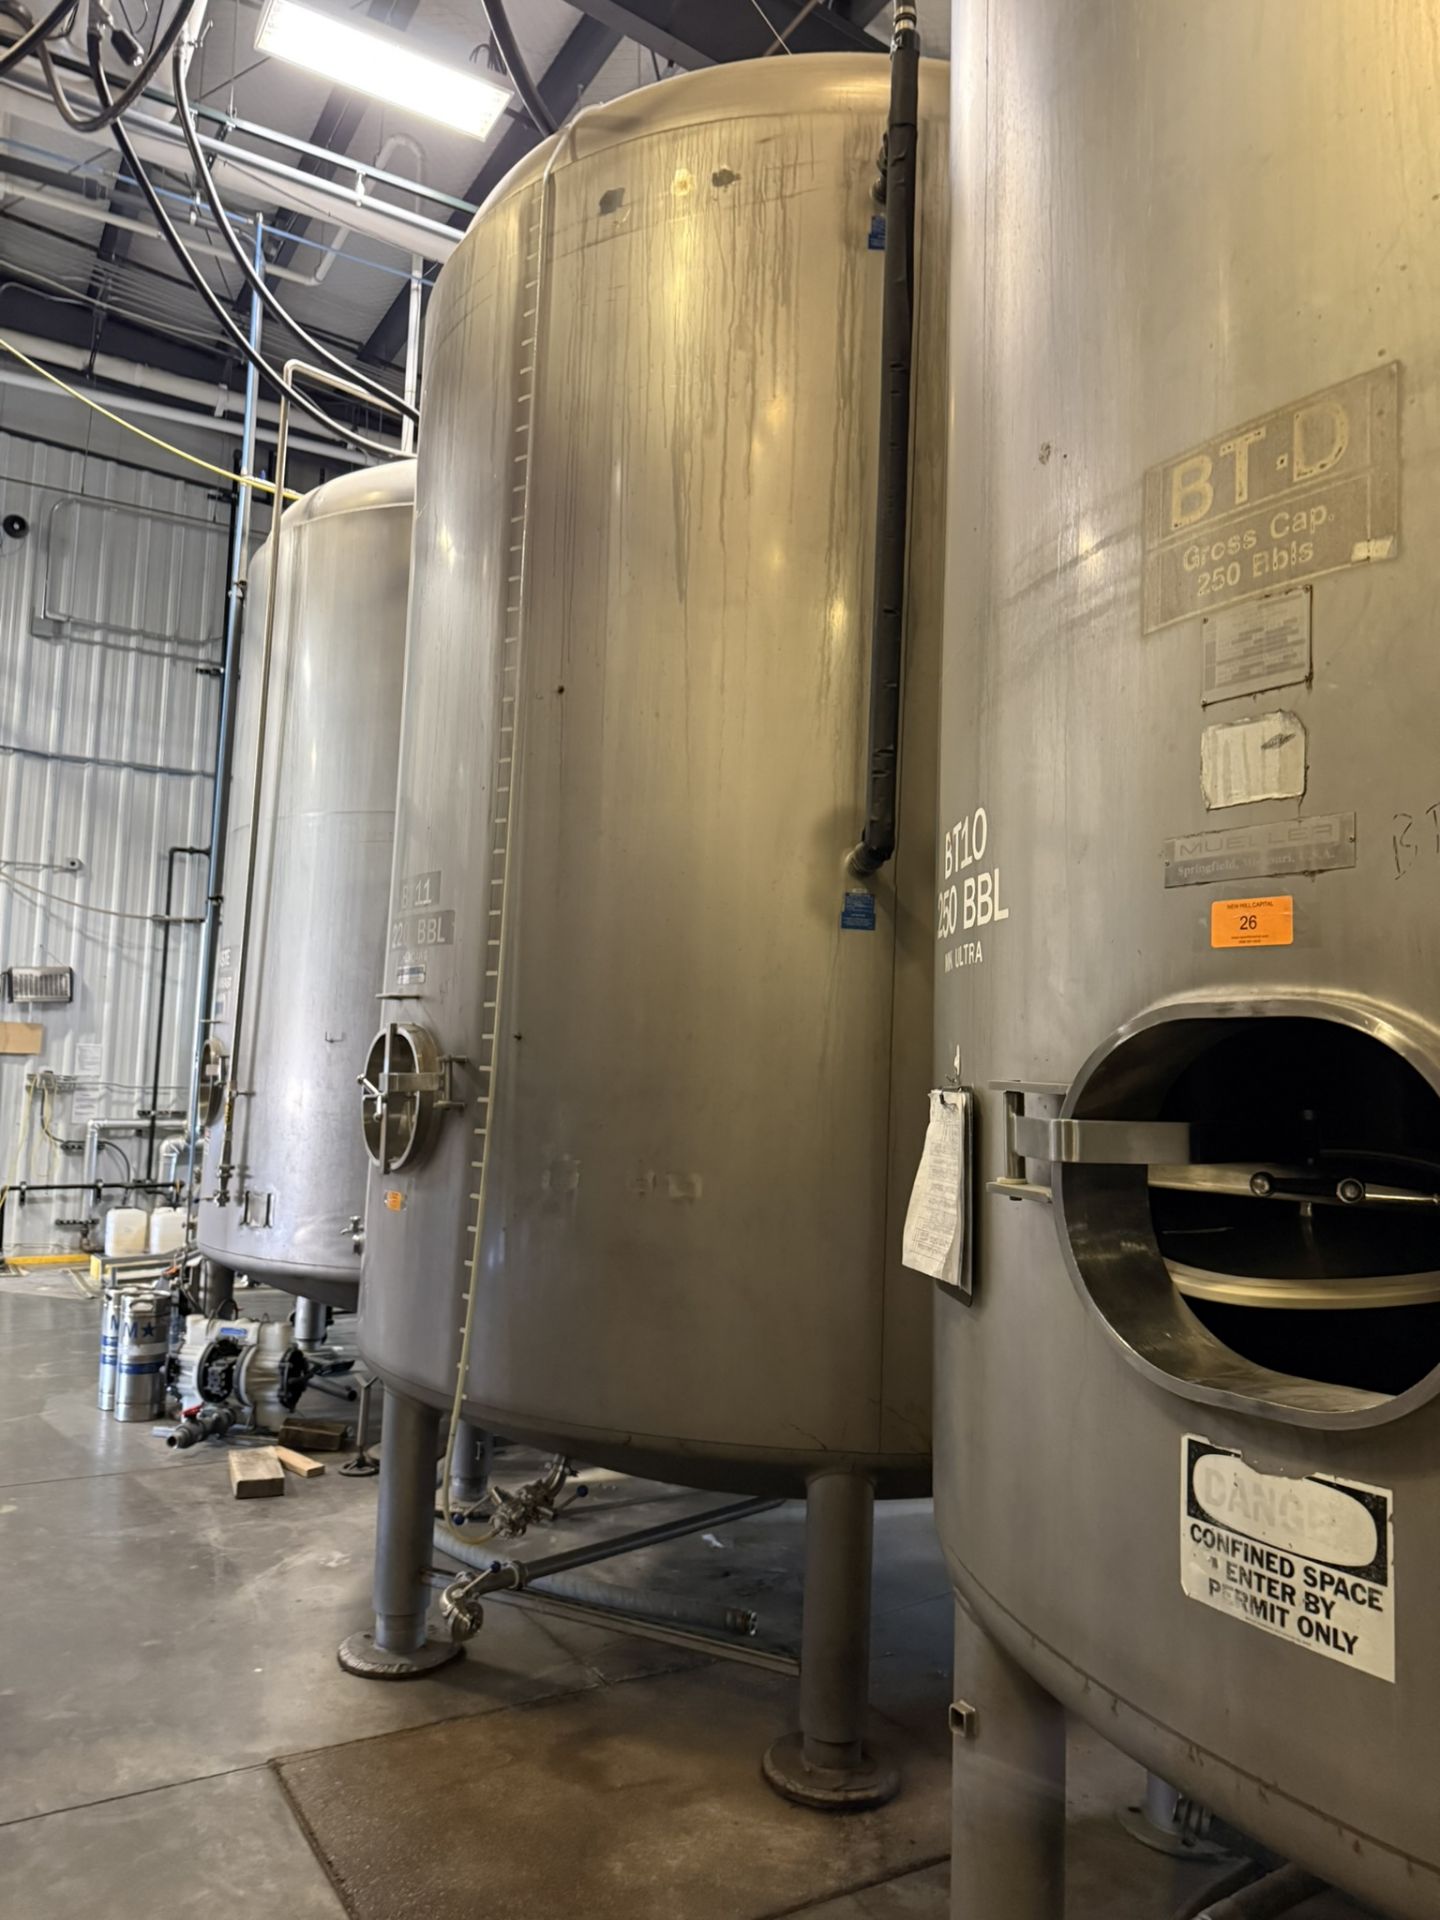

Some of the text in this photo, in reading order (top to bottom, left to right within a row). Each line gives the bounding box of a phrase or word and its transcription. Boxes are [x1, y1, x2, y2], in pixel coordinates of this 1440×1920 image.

[1182, 504, 1335, 572] Gross Cap.
[1196, 561, 1241, 597] 250
[944, 807, 988, 880] BT10
[417, 916, 446, 945] BBL
[937, 884, 958, 939] 250
[962, 868, 1009, 930] BBL
[1240, 915, 1257, 930] 26
[955, 940, 983, 968] ULTRA
[1190, 1523, 1384, 1613] CONFINED SPACE
[1226, 1560, 1337, 1621] ENTER BY
[1208, 1577, 1290, 1628] PERMIT
[1296, 1615, 1359, 1656] ONLY
